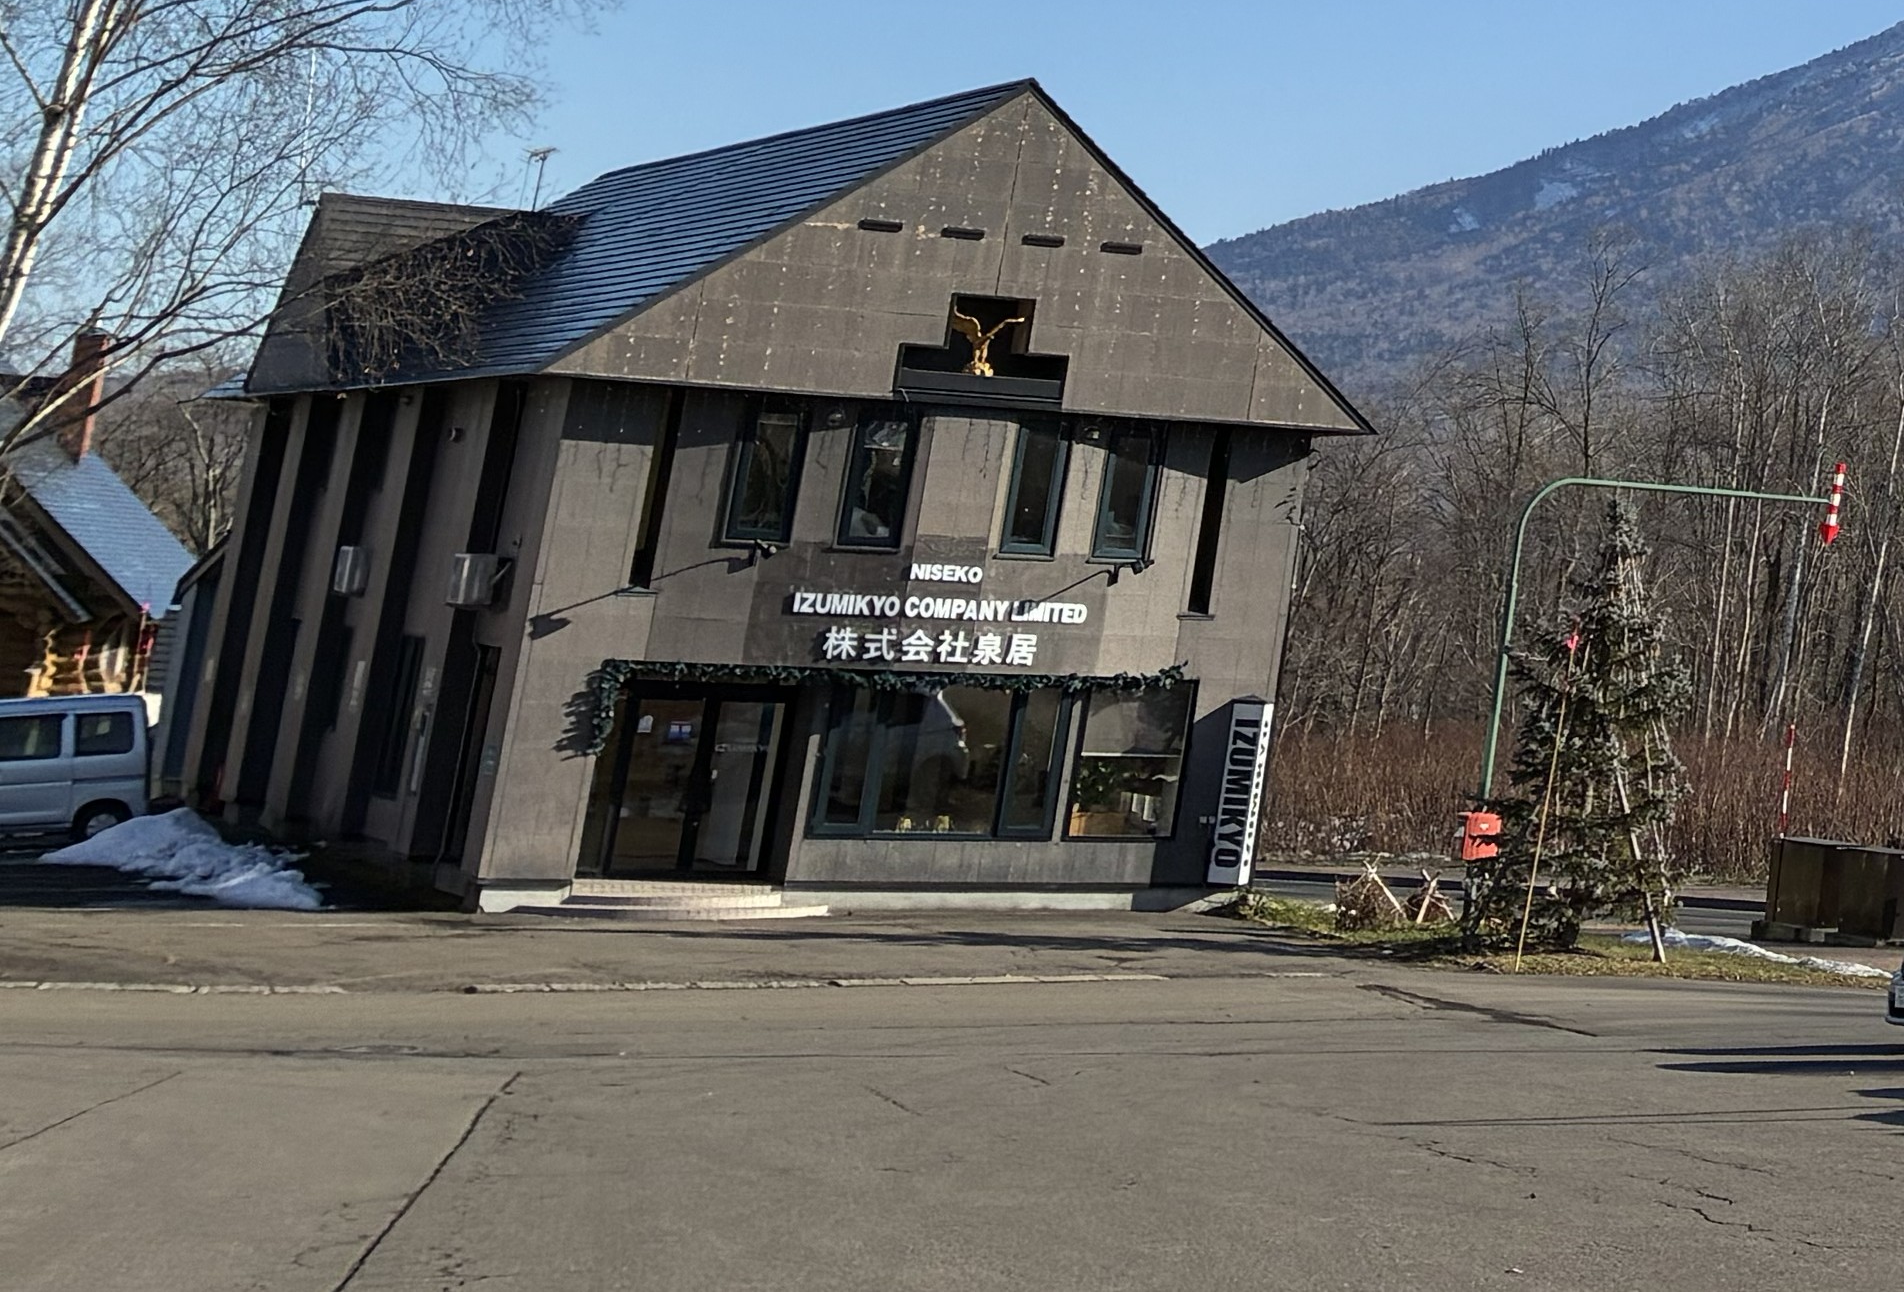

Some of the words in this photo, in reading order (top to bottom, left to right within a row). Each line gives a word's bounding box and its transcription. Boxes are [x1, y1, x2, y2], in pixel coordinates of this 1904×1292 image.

[909, 563, 983, 584] NISEKO
[792, 592, 900, 617] IZUMIKYO
[904, 596, 1009, 622] COMPANY
[1011, 601, 1088, 625] LIMITED
[822, 626, 1038, 666] 株式会社泉居
[1214, 719, 1260, 868] IZUMIKYO
